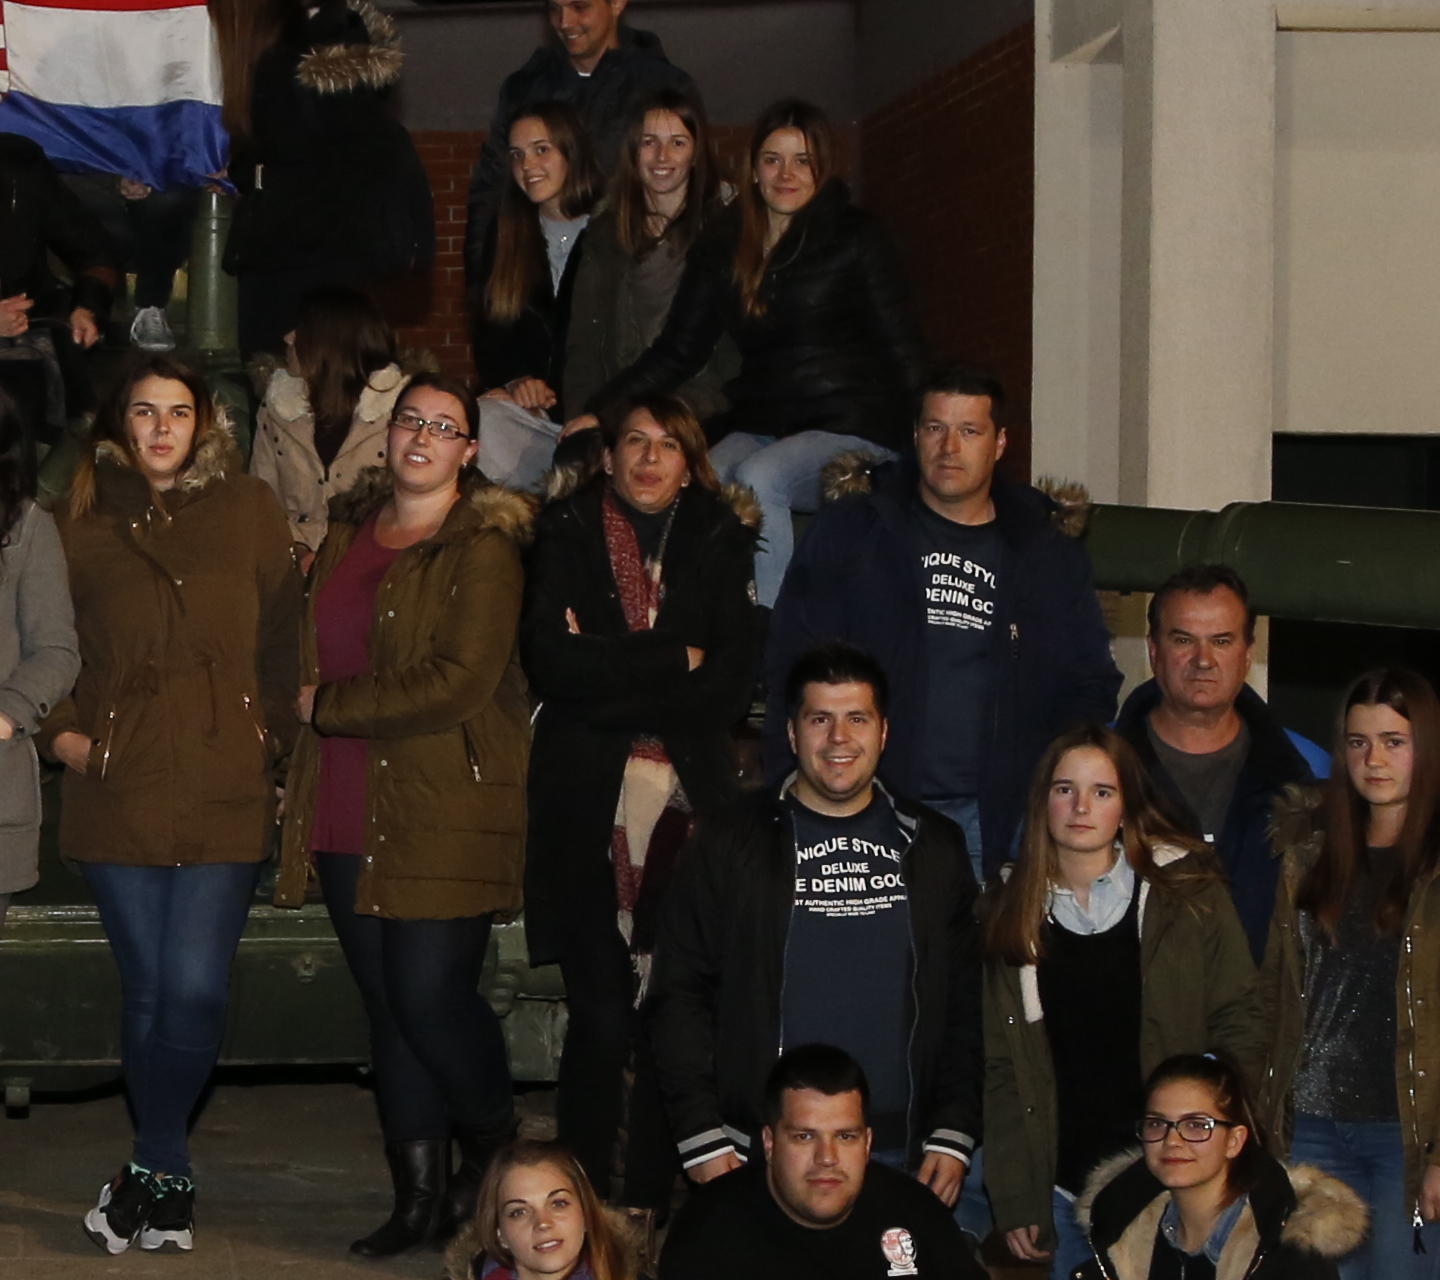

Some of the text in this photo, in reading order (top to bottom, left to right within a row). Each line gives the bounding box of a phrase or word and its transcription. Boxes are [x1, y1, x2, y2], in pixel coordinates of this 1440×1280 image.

[921, 552, 962, 569] IQUE
[931, 573, 976, 595] DELUXE
[852, 838, 901, 863] STYLE
[821, 862, 870, 875] DELUXE
[811, 877, 867, 893] DENIM
